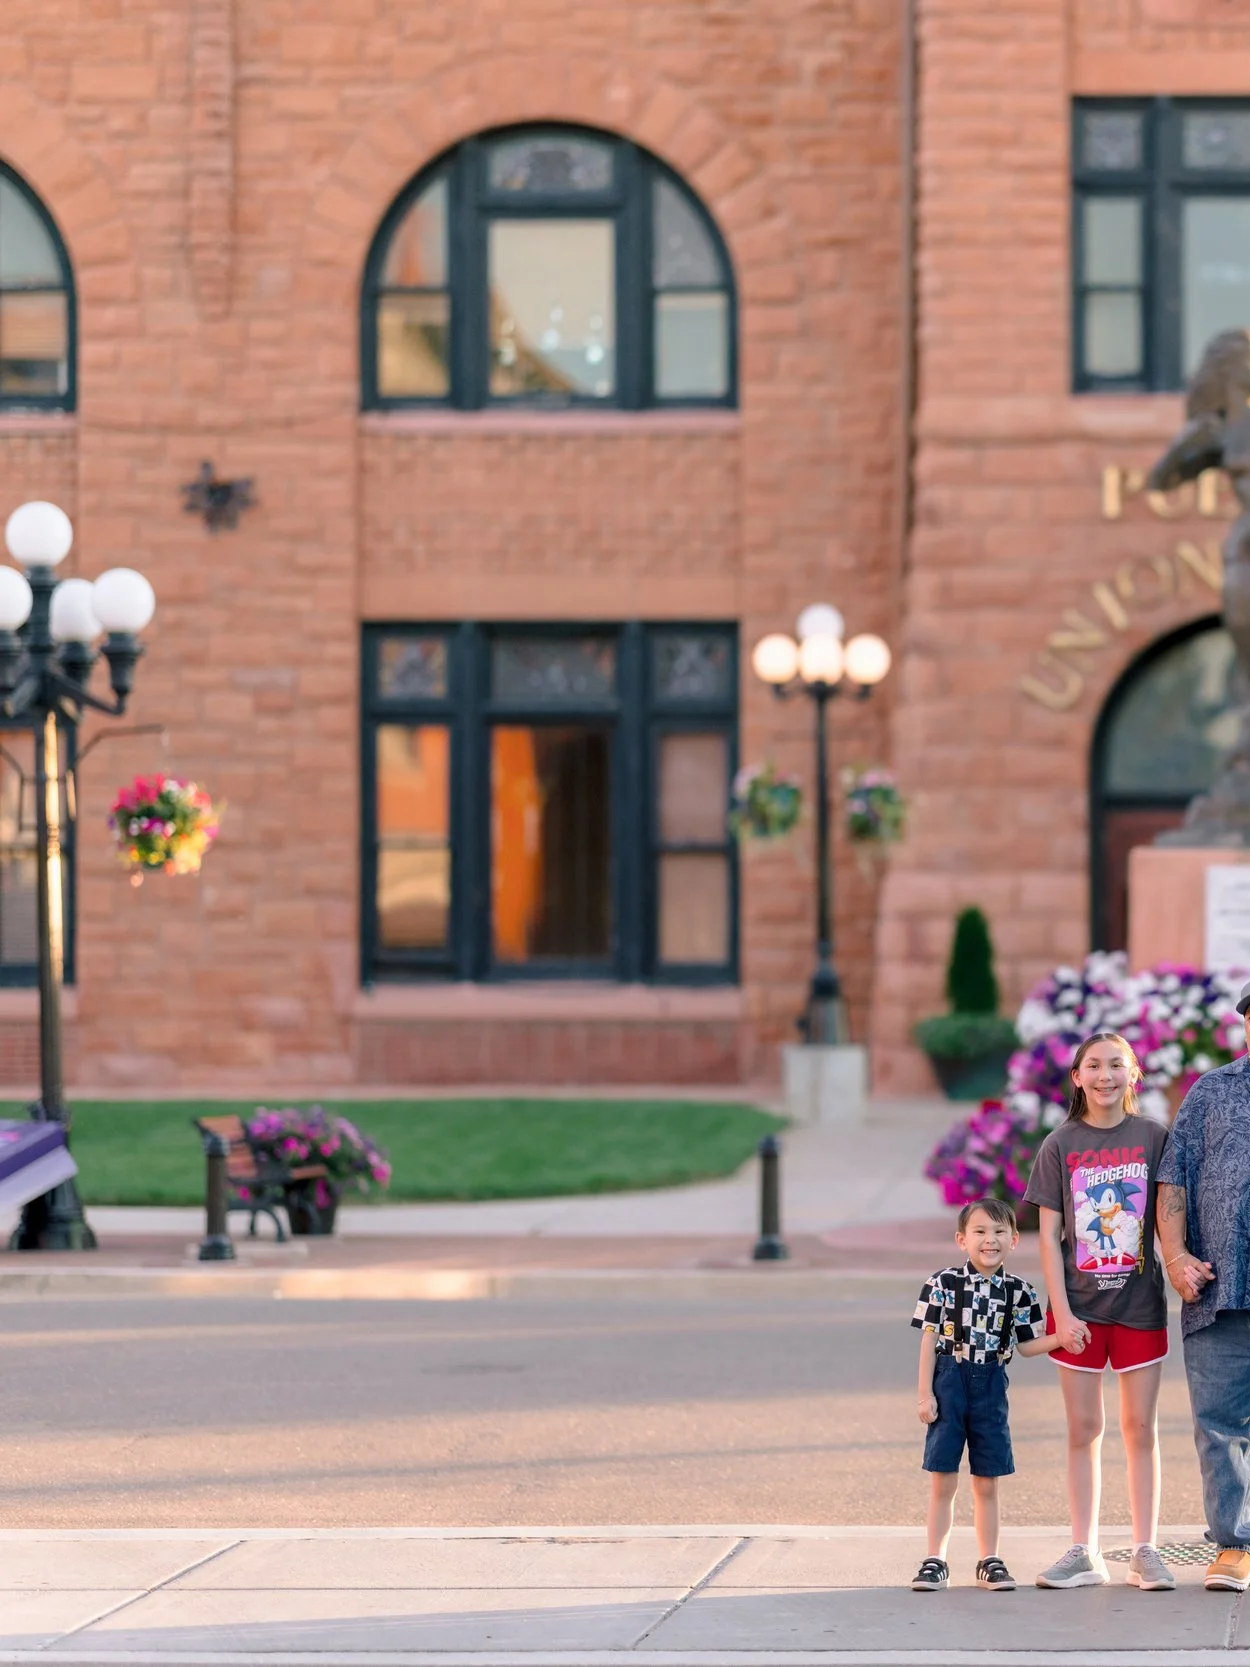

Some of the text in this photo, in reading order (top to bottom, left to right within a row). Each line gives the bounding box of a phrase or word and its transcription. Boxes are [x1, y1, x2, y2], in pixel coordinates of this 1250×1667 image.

[1066, 1145, 1146, 1174] SONIC
[1080, 1167, 1095, 1178] THE
[1087, 1162, 1149, 1188] HEDGEHOG
